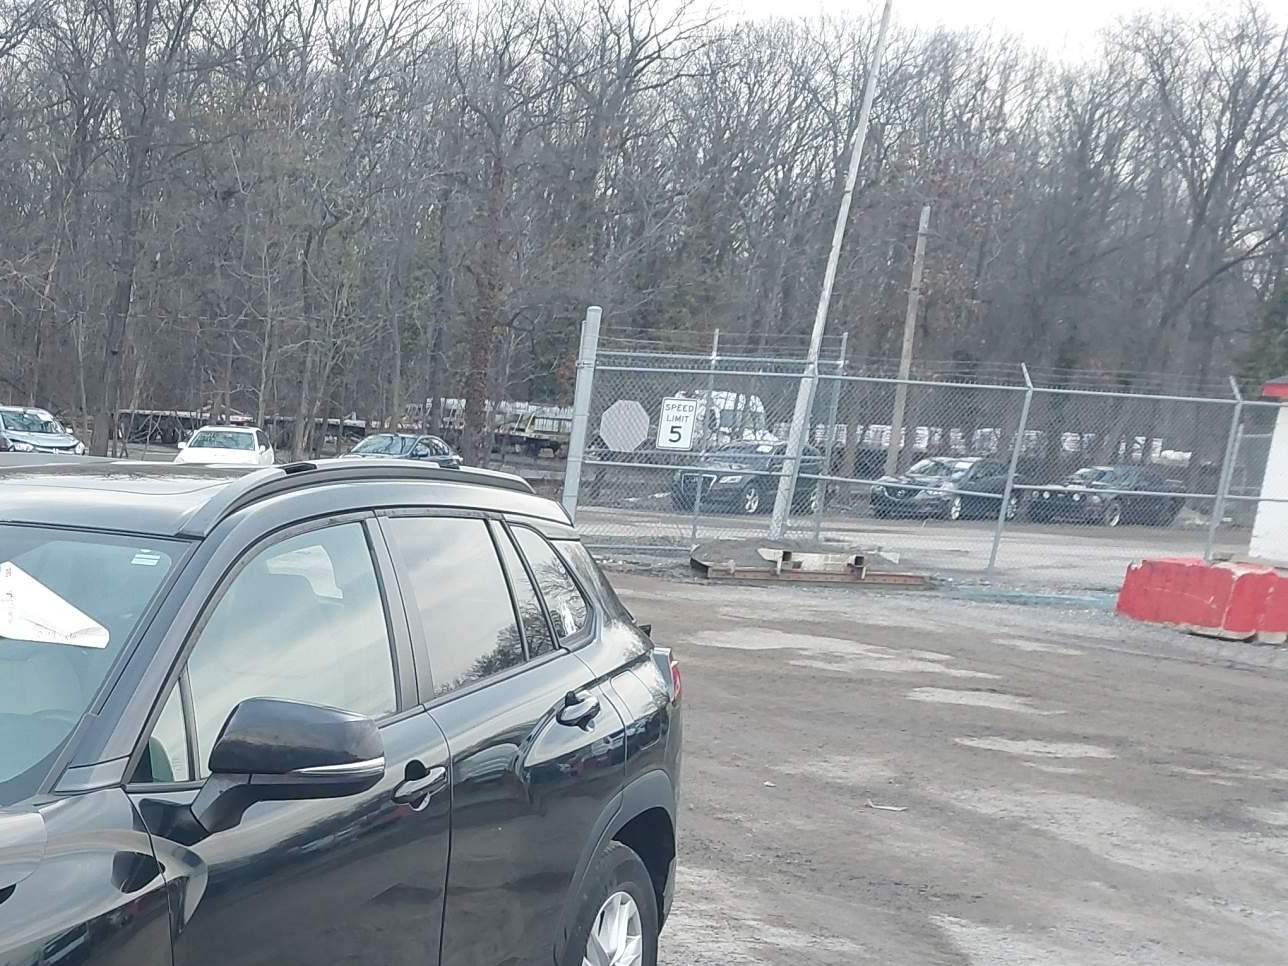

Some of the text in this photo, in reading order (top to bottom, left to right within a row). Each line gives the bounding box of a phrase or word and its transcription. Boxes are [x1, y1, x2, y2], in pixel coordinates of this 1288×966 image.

[665, 403, 694, 413] SPEED
[666, 414, 690, 423] LIMIT
[668, 425, 683, 443] 5
